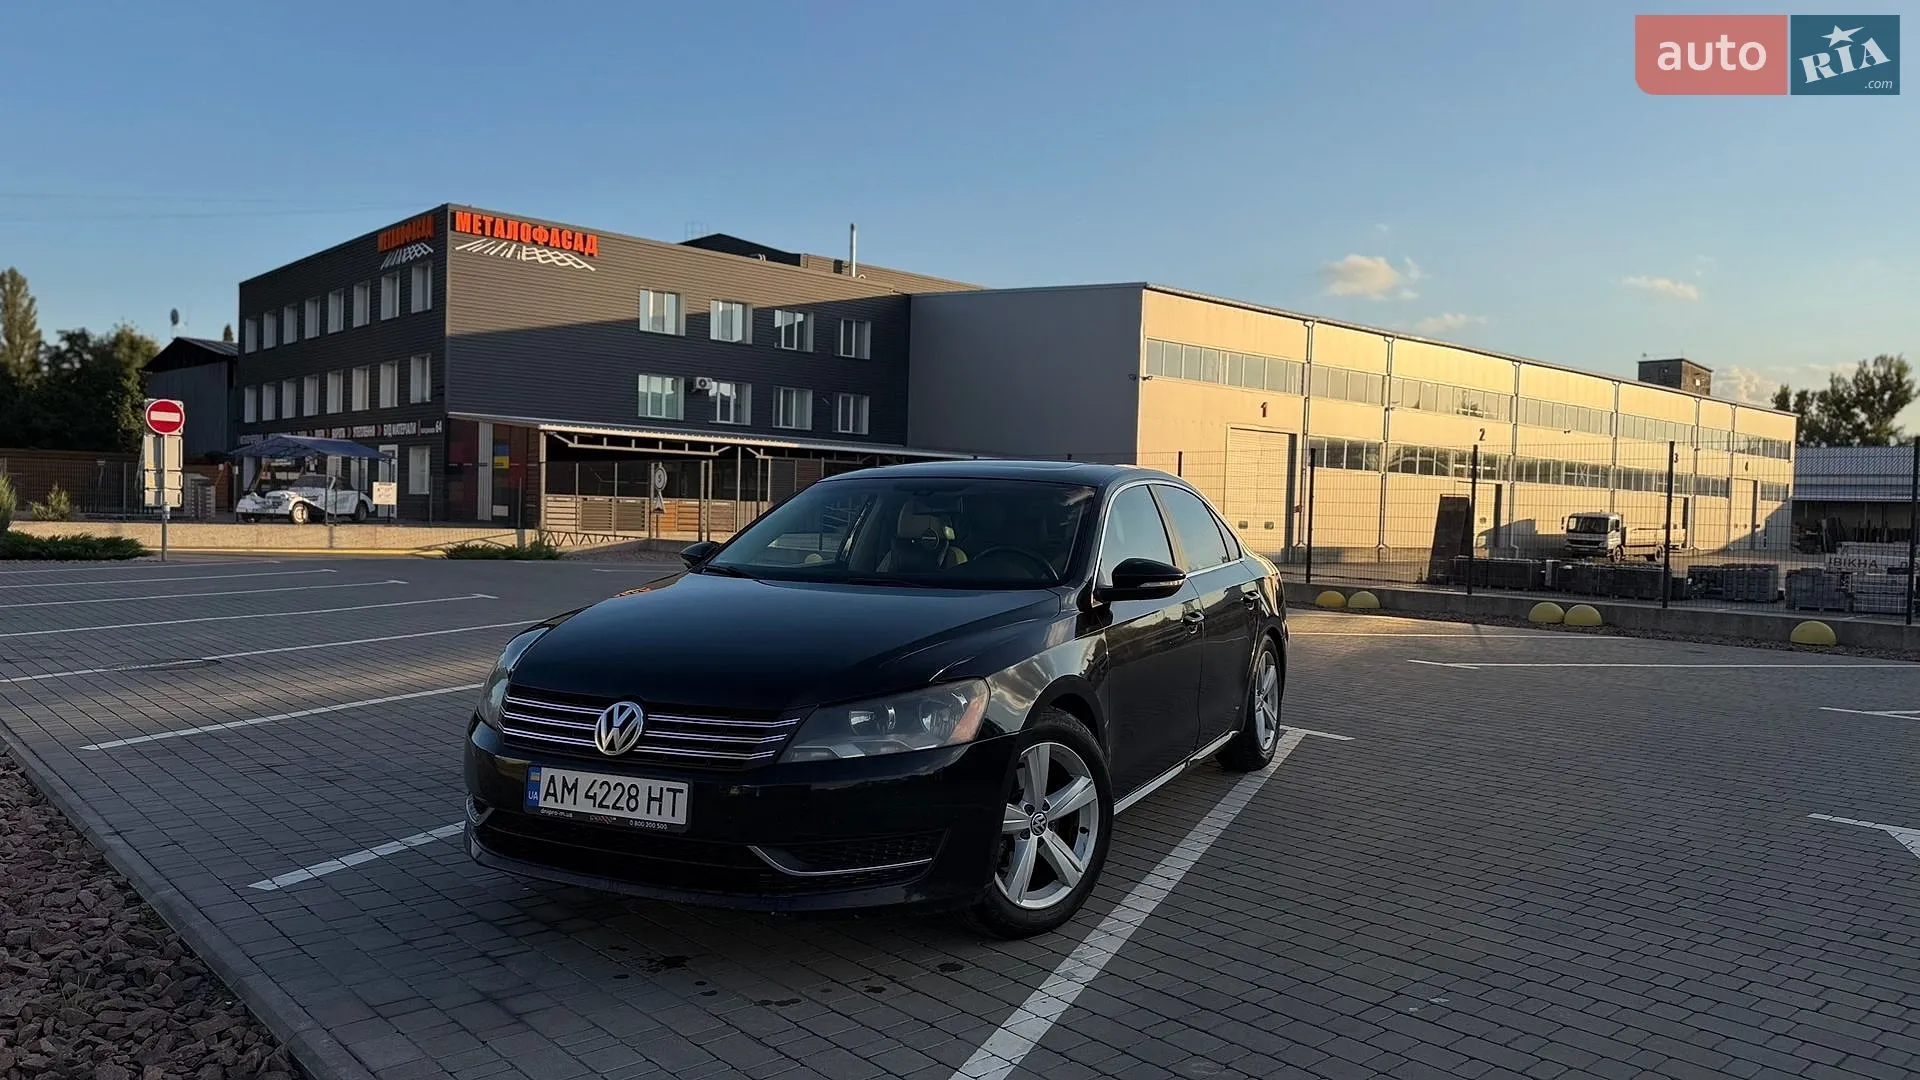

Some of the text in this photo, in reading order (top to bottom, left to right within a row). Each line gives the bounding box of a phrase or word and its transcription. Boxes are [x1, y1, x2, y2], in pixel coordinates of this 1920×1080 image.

[455, 211, 598, 256] МЕТАЛОФАСАД
[1260, 401, 1267, 418] 1
[1478, 428, 1486, 442] 2
[1674, 452, 1679, 463] 3
[528, 790, 538, 801] UA
[543, 774, 684, 817] AM 4228 HT
